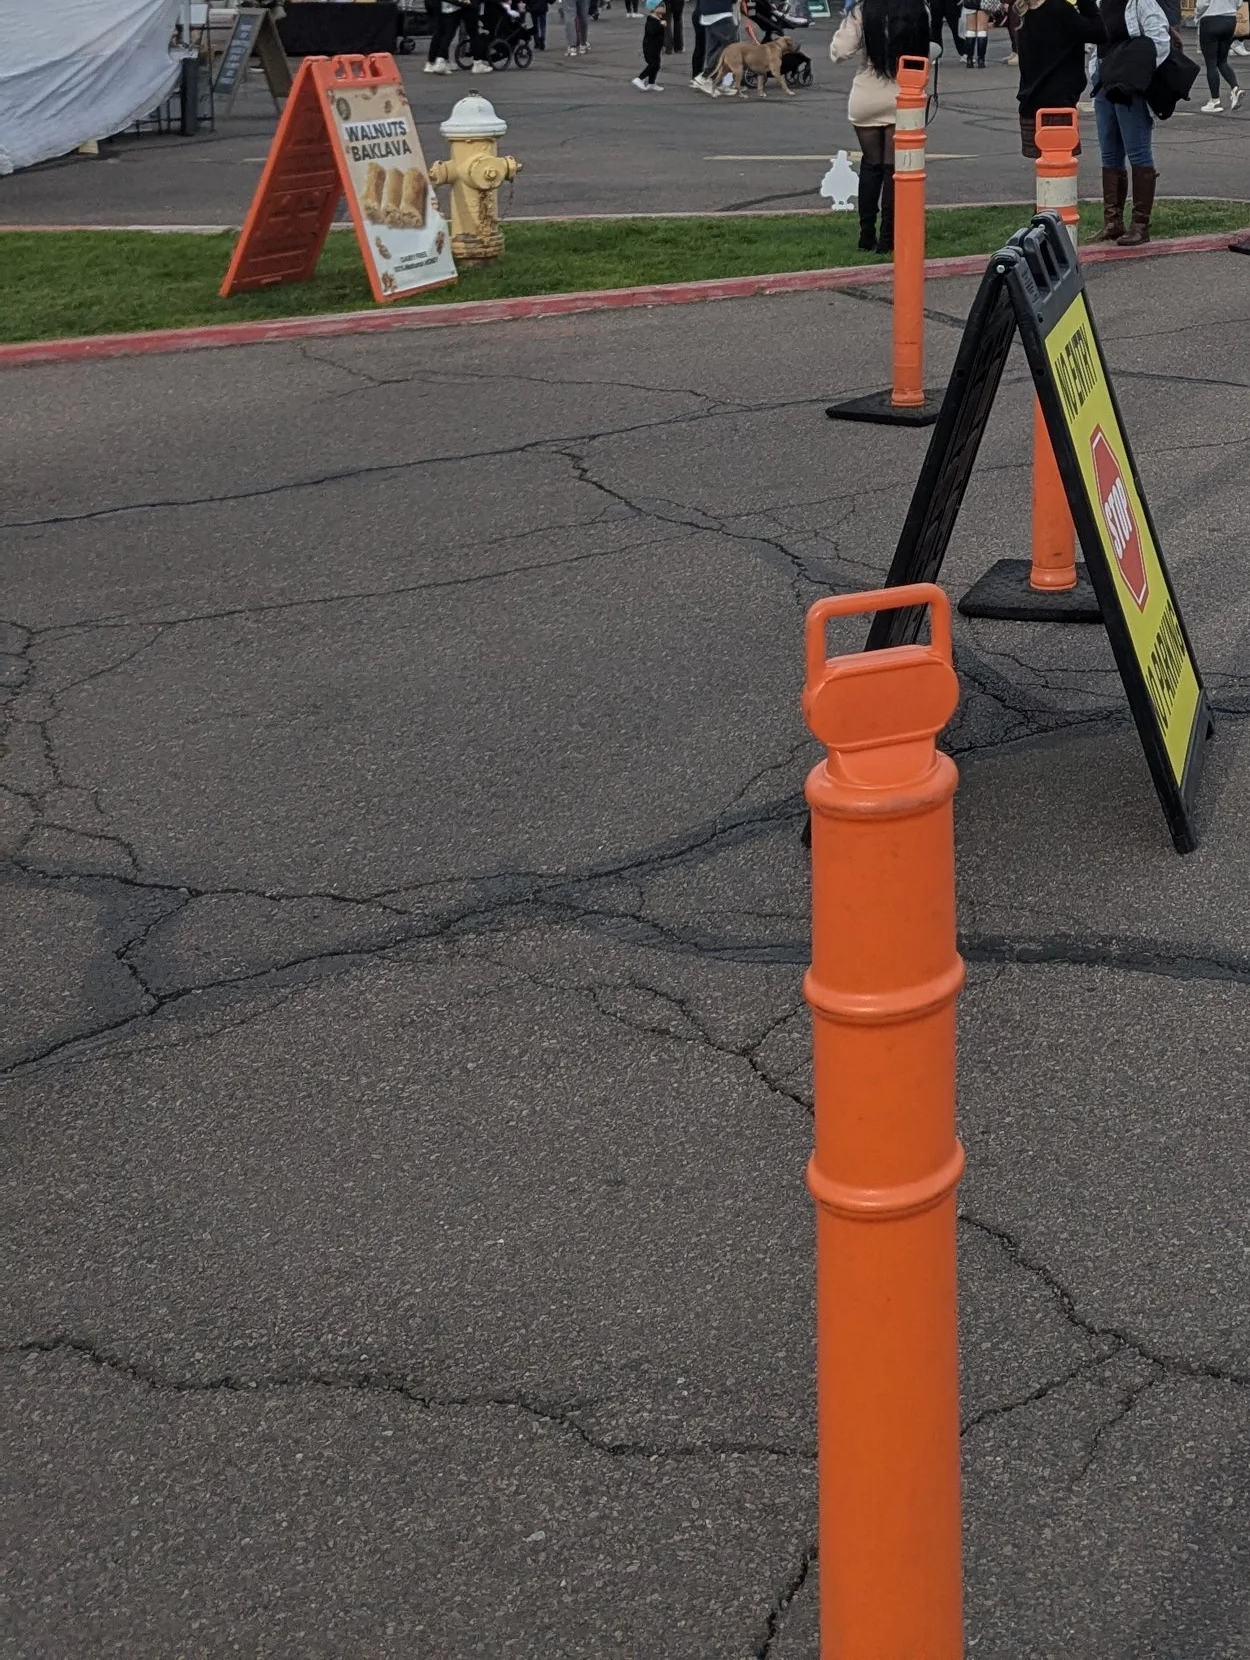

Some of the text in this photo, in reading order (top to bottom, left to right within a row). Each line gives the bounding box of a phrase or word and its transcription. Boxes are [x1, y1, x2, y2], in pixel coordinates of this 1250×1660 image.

[345, 120, 408, 143] WALNUTS
[351, 139, 413, 162] BAKLAVA
[1054, 322, 1098, 425] NO ENTRY
[1104, 476, 1132, 560] STOP
[1151, 598, 1186, 717] PARKING
